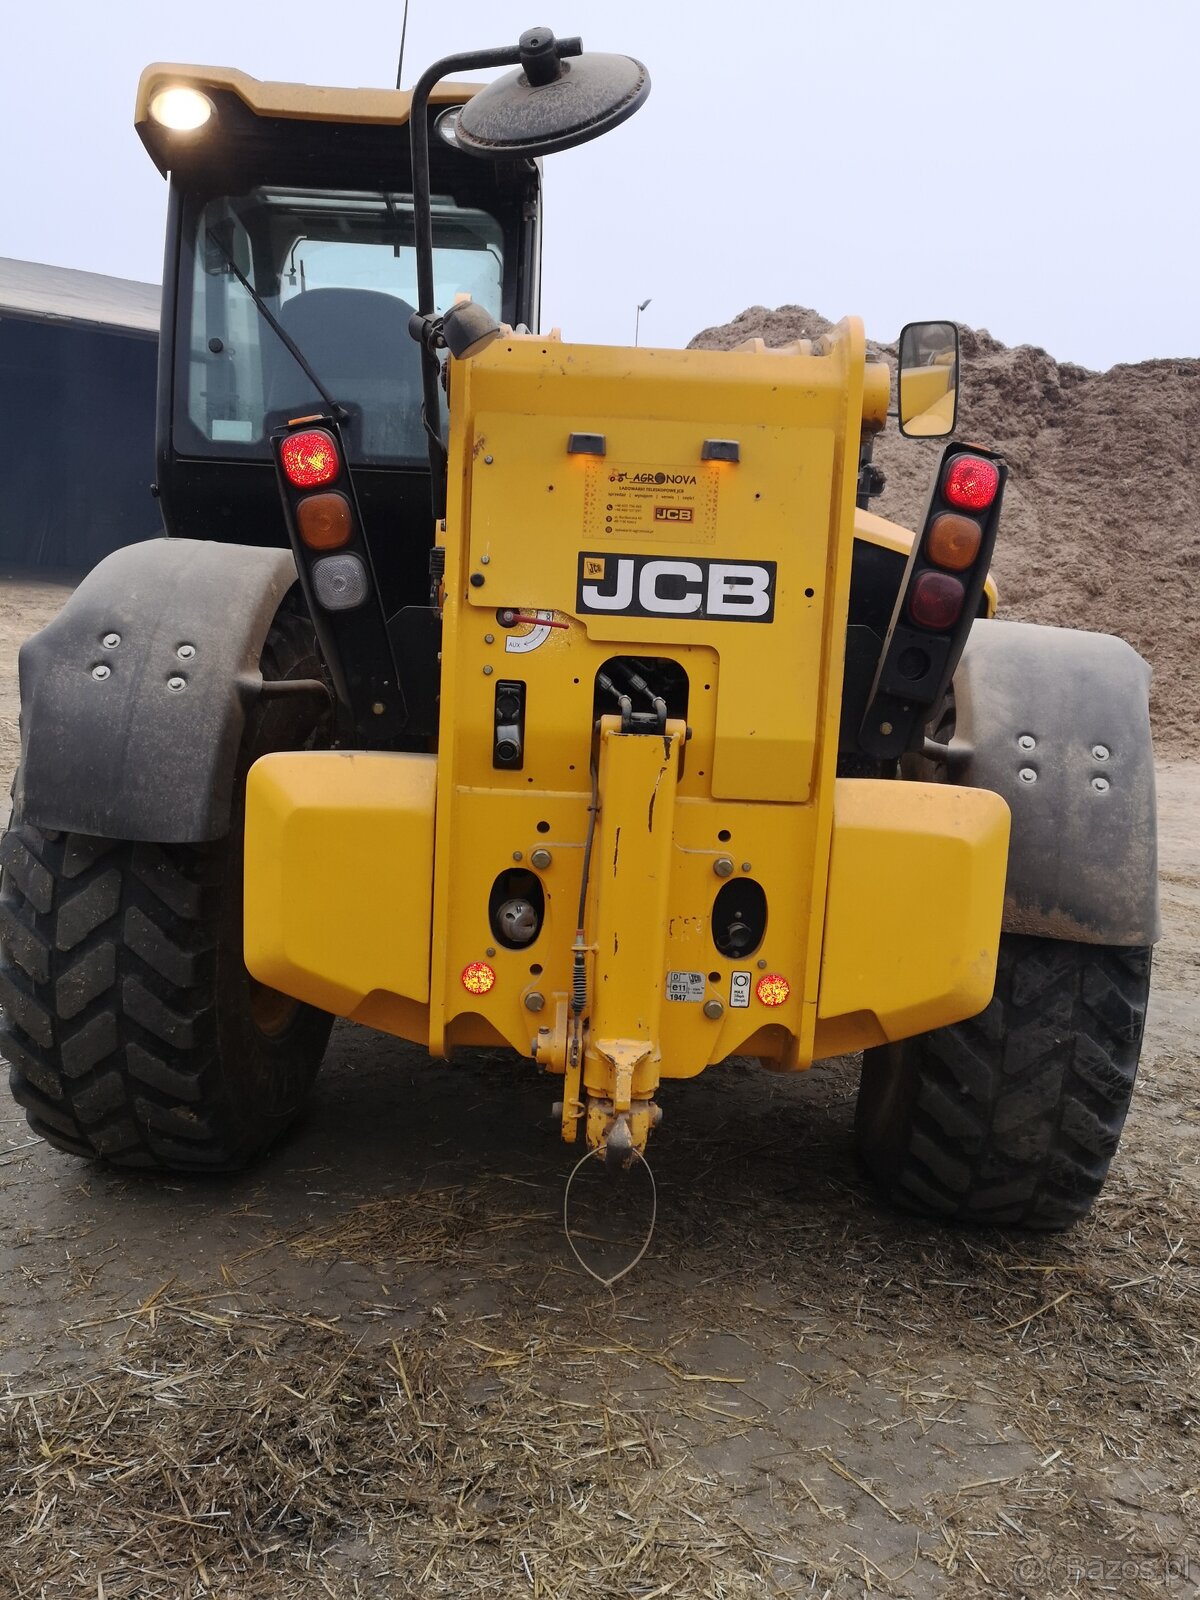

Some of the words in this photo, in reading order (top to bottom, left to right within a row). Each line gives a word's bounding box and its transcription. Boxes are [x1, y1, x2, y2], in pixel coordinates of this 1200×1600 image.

[633, 472, 697, 485] AGRONOVA
[656, 508, 692, 520] JCB
[582, 559, 770, 616] JCB
[672, 984, 686, 992] e11
[670, 993, 687, 1001] 1947
